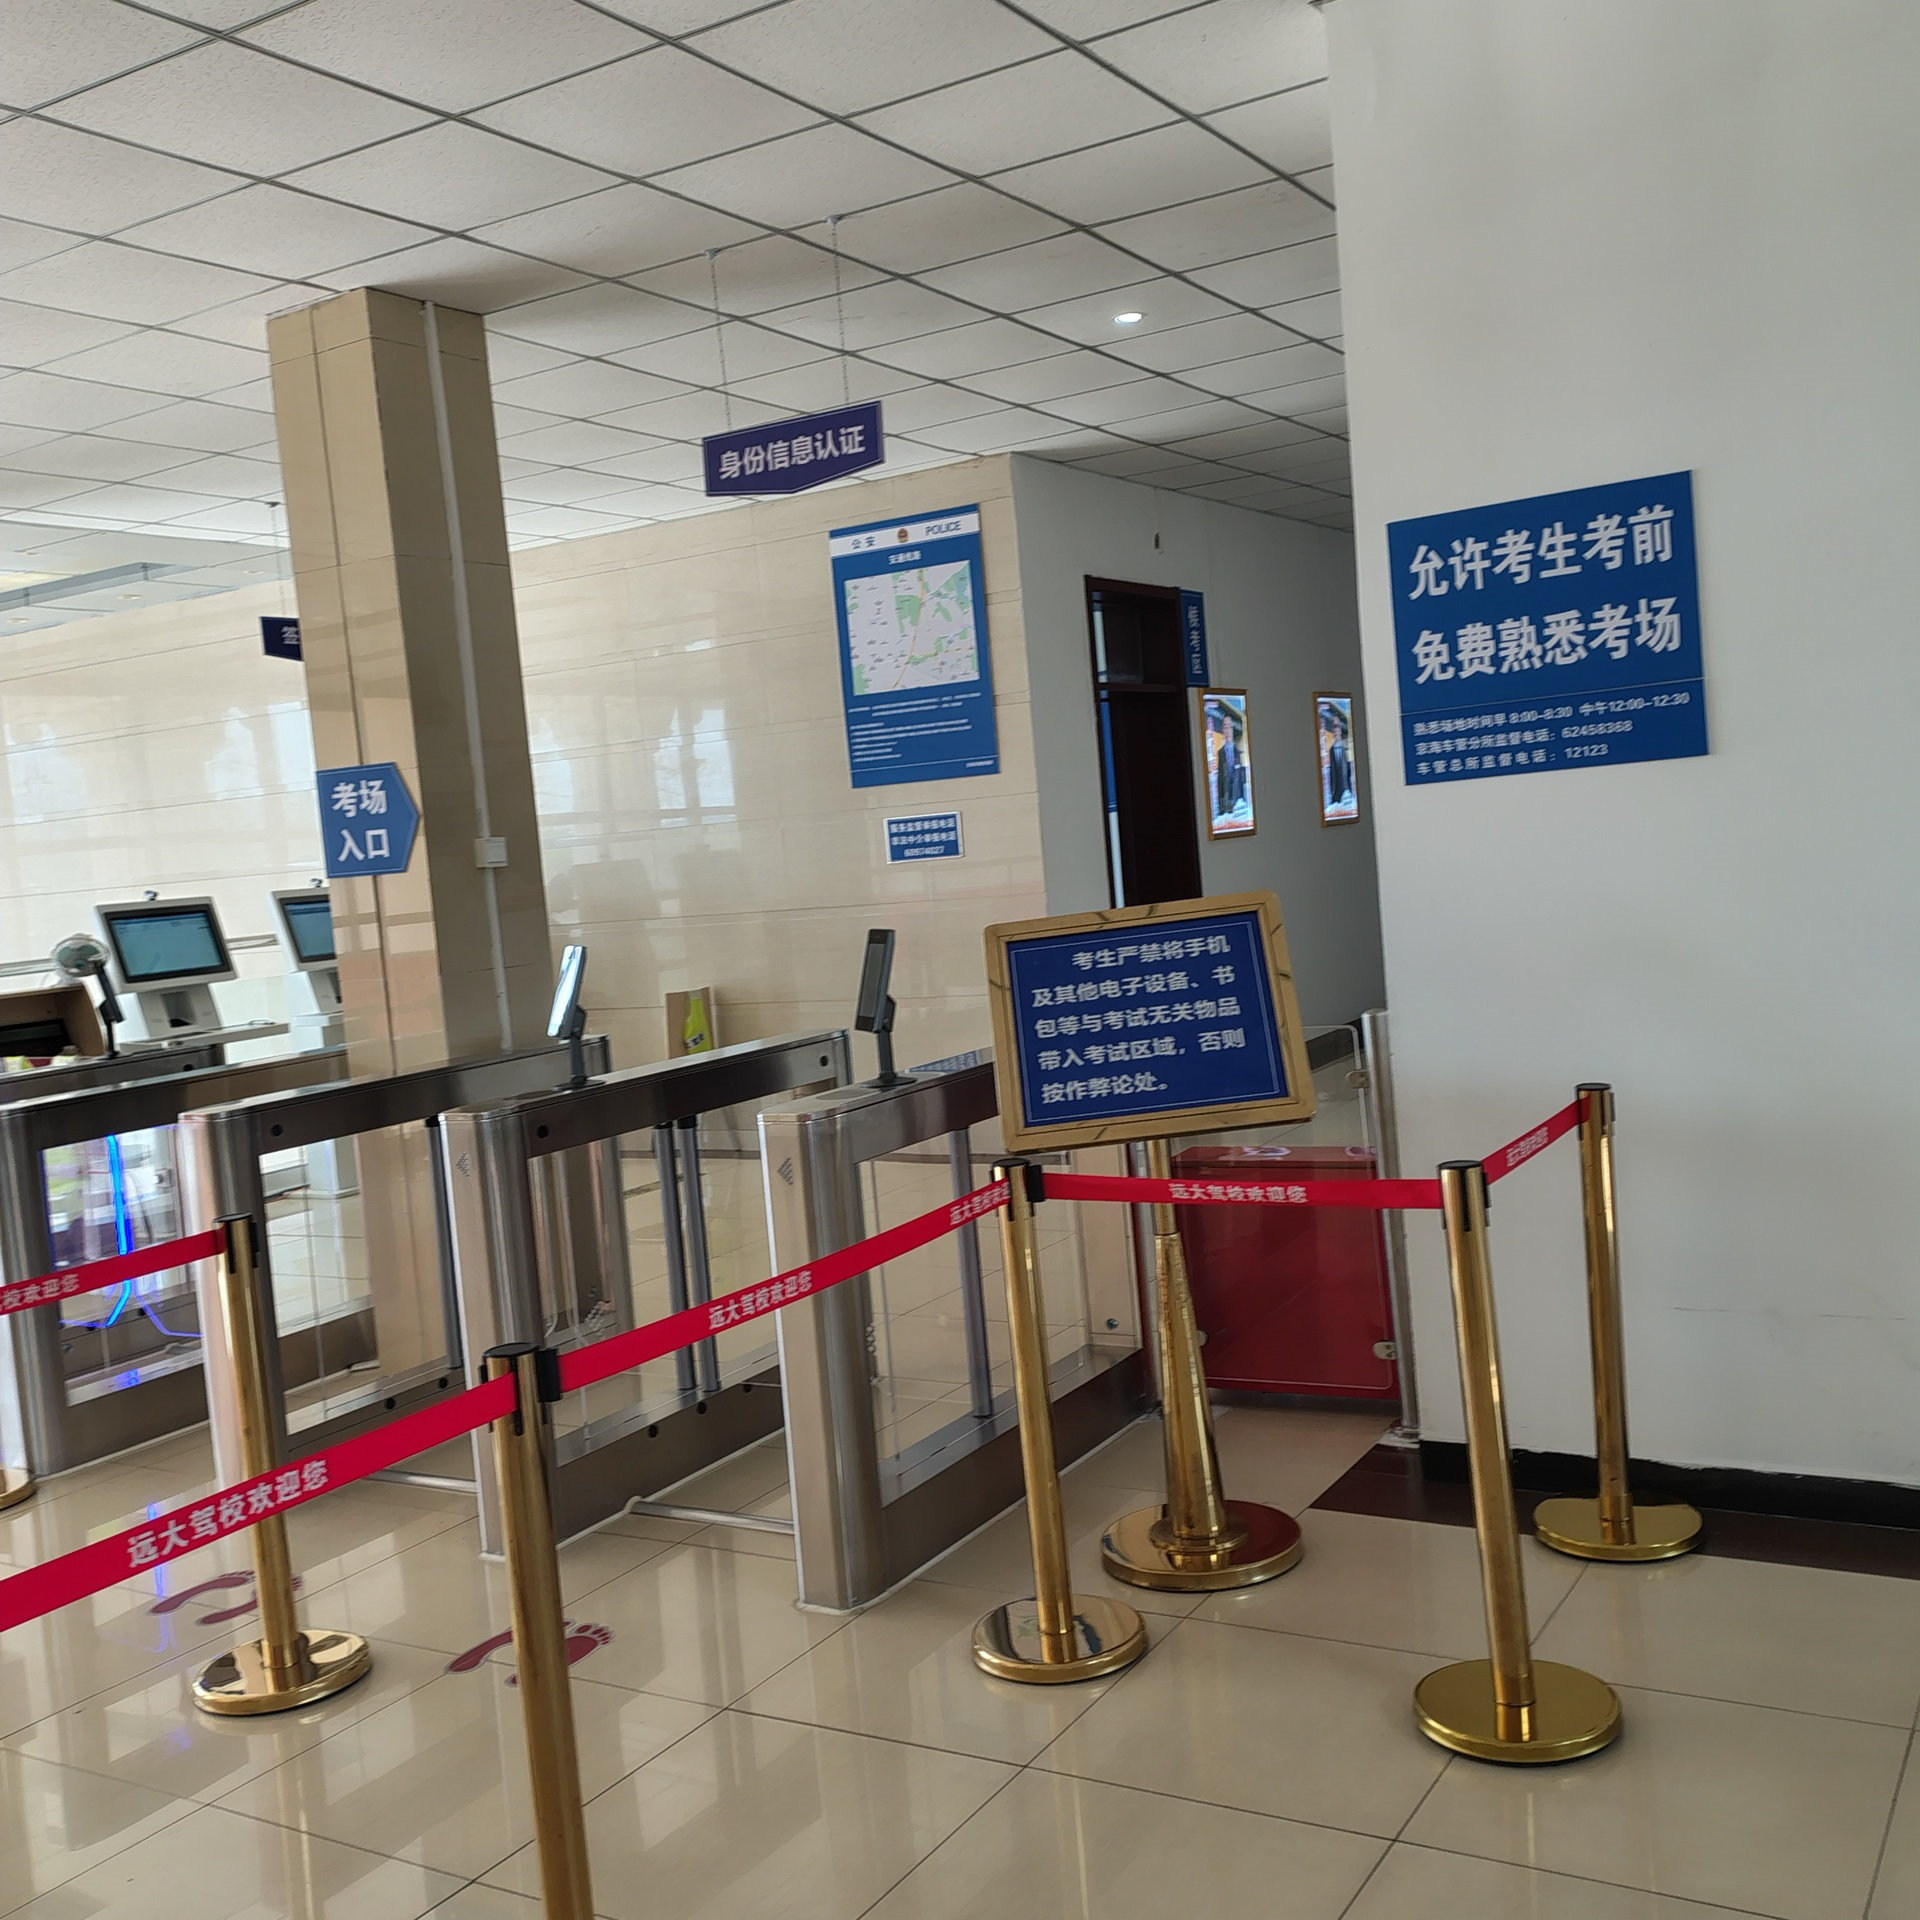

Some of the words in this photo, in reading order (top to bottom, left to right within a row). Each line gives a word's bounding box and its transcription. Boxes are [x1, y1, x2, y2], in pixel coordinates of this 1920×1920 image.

[718, 424, 866, 481] 身份信息认证
[924, 520, 962, 537] POLICE
[1408, 503, 1676, 601] 允许考生考前
[1411, 595, 1684, 684] 免费熟悉考场
[330, 778, 388, 818] 考场
[337, 828, 391, 863] 入口
[1071, 934, 1232, 972] 考生严禁将手机
[1031, 965, 1236, 1009] 及其他电子设备、书
[1034, 996, 1242, 1039] 包等与考试无关物品
[1041, 1071, 1169, 1105] 按作弊论处。
[1168, 1181, 1310, 1204] 远大驾校欢迎您
[0, 1273, 80, 1311] 校欢迎您
[708, 1269, 813, 1331] 远大驾校欢迎您
[127, 1459, 329, 1568] 远大驾校欢迎您
